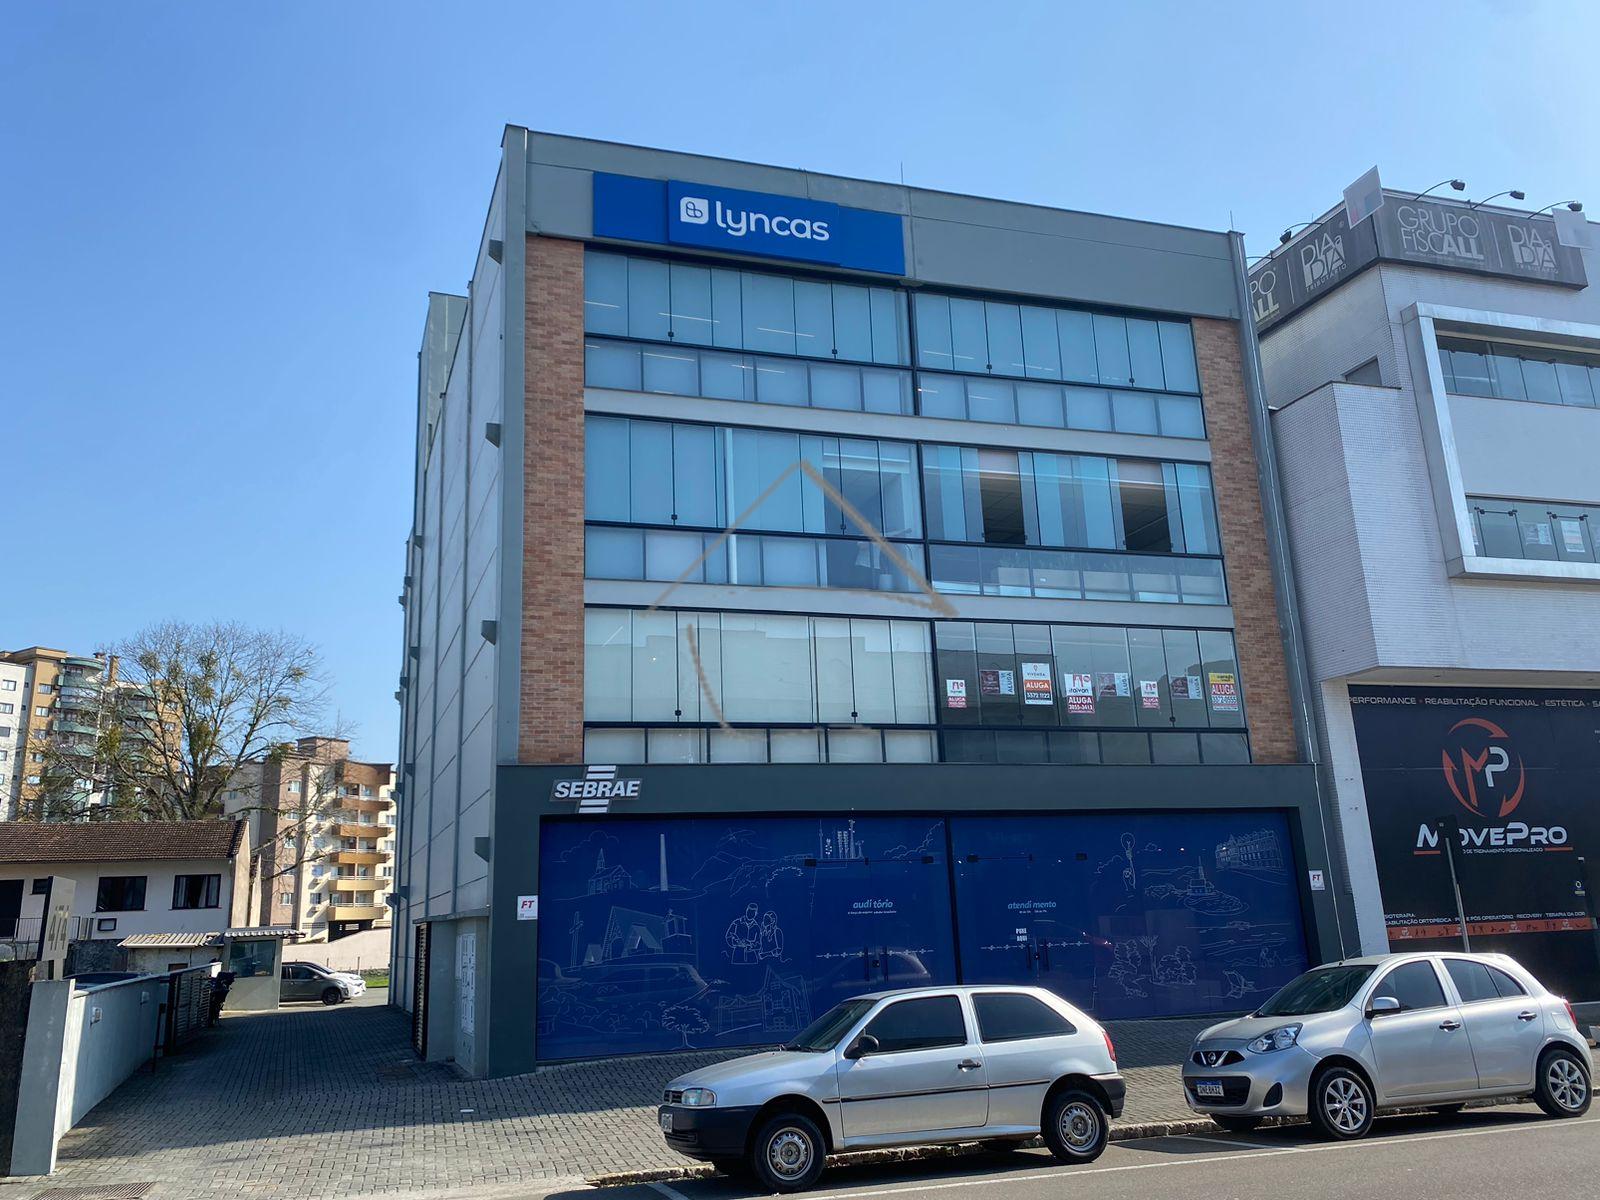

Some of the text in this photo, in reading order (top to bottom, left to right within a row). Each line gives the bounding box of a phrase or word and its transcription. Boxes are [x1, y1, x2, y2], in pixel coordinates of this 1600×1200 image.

[715, 200, 830, 241] lyncas
[1397, 205, 1479, 239] GRUPO
[1211, 684, 1236, 695] ALUGA
[1424, 697, 1488, 708] REABILITAÇÃO
[1490, 698, 1539, 707] FUNCIONAL
[1544, 698, 1585, 707] ESTÉTICA
[554, 780, 641, 798] SEBRAE
[521, 900, 535, 909] FT
